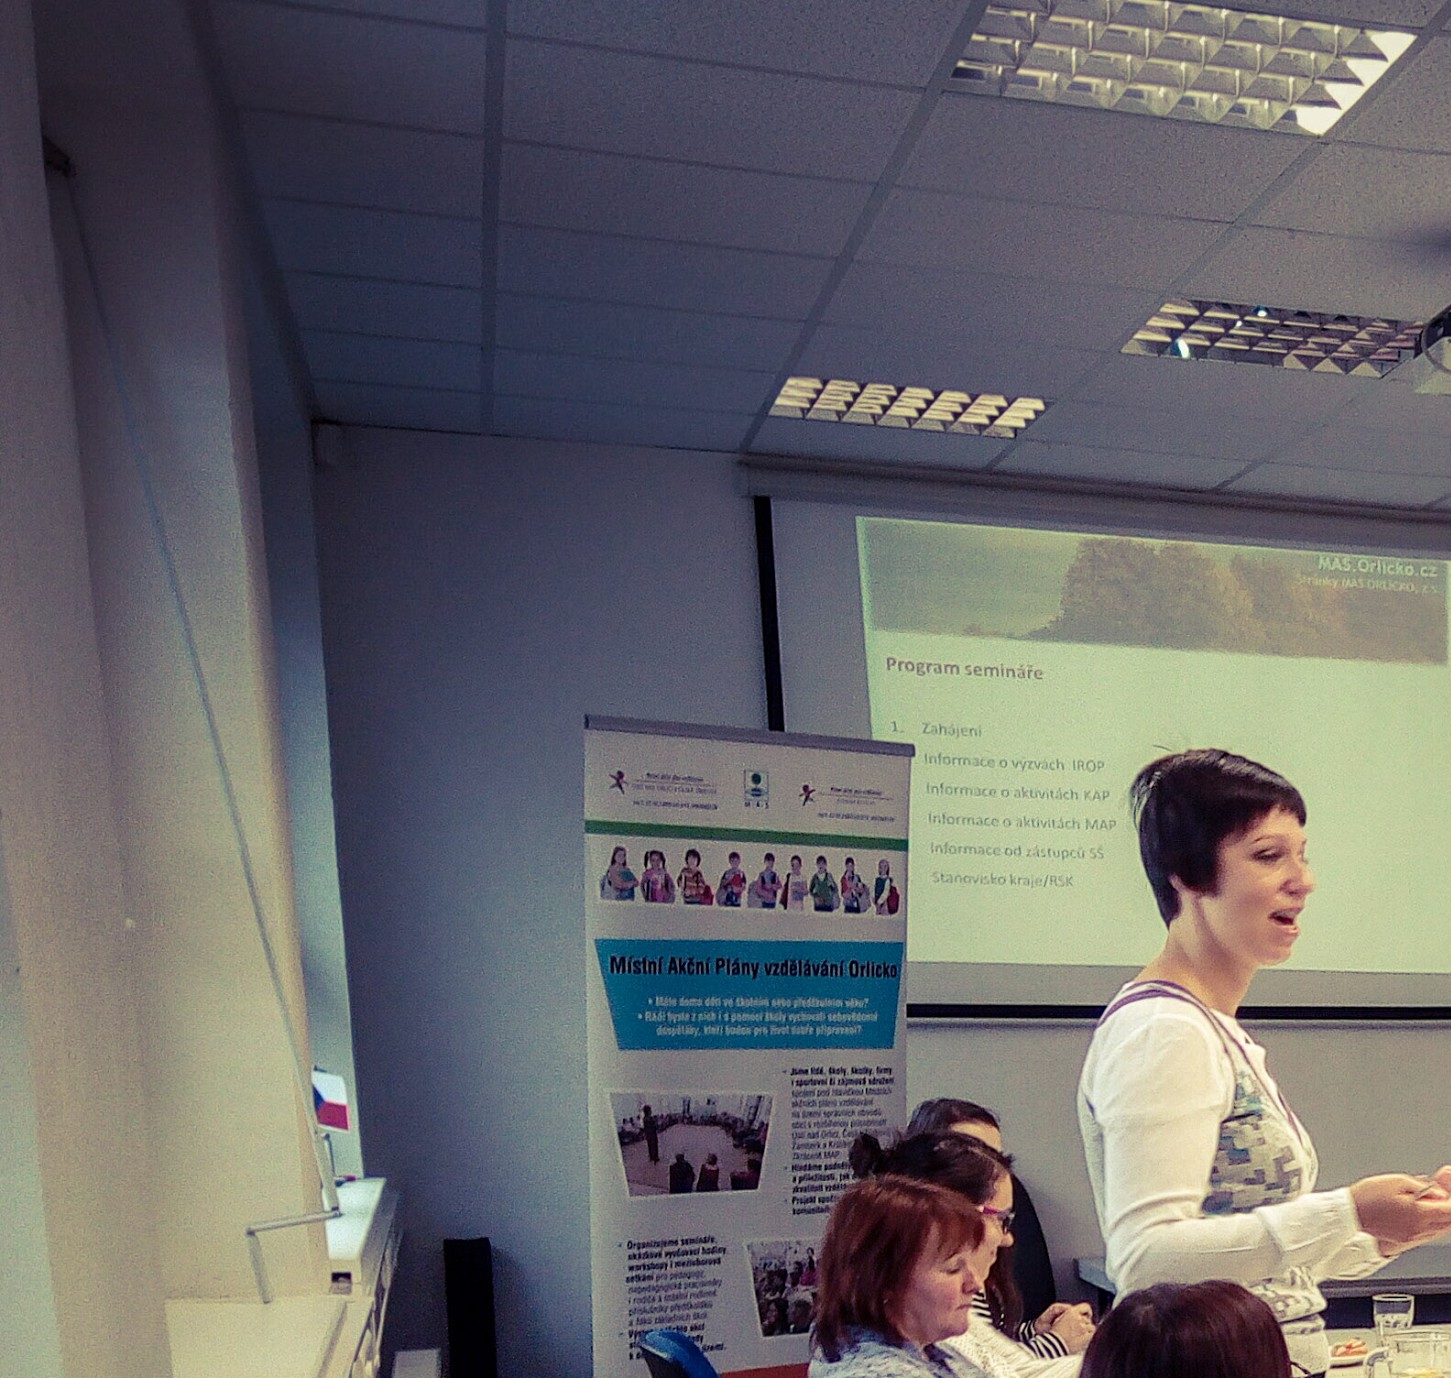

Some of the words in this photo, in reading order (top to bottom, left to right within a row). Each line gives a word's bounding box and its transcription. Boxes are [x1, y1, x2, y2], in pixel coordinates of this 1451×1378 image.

[886, 656, 960, 676] Program
[964, 663, 1044, 680] semináře
[921, 721, 982, 739] Zahájení
[924, 753, 996, 769] Informace
[1000, 760, 1008, 768] o
[1072, 759, 1105, 773] IROP
[926, 782, 997, 797] Informace
[1001, 789, 1010, 798] o
[1014, 786, 1079, 800] aktivitách
[1084, 790, 1110, 801] KAP
[928, 812, 999, 827] Informace
[1003, 819, 1012, 827] o
[1016, 817, 1081, 830] aktivitách
[1085, 818, 1117, 831] MAP
[930, 841, 1000, 856] Informace
[1004, 843, 1022, 857] od
[932, 871, 1006, 886] Stanovisko
[609, 954, 664, 975] Místní
[667, 956, 711, 976] Akční
[715, 957, 759, 980] Plány
[764, 958, 844, 978] vzdělávání
[848, 959, 898, 979] Orlicko
